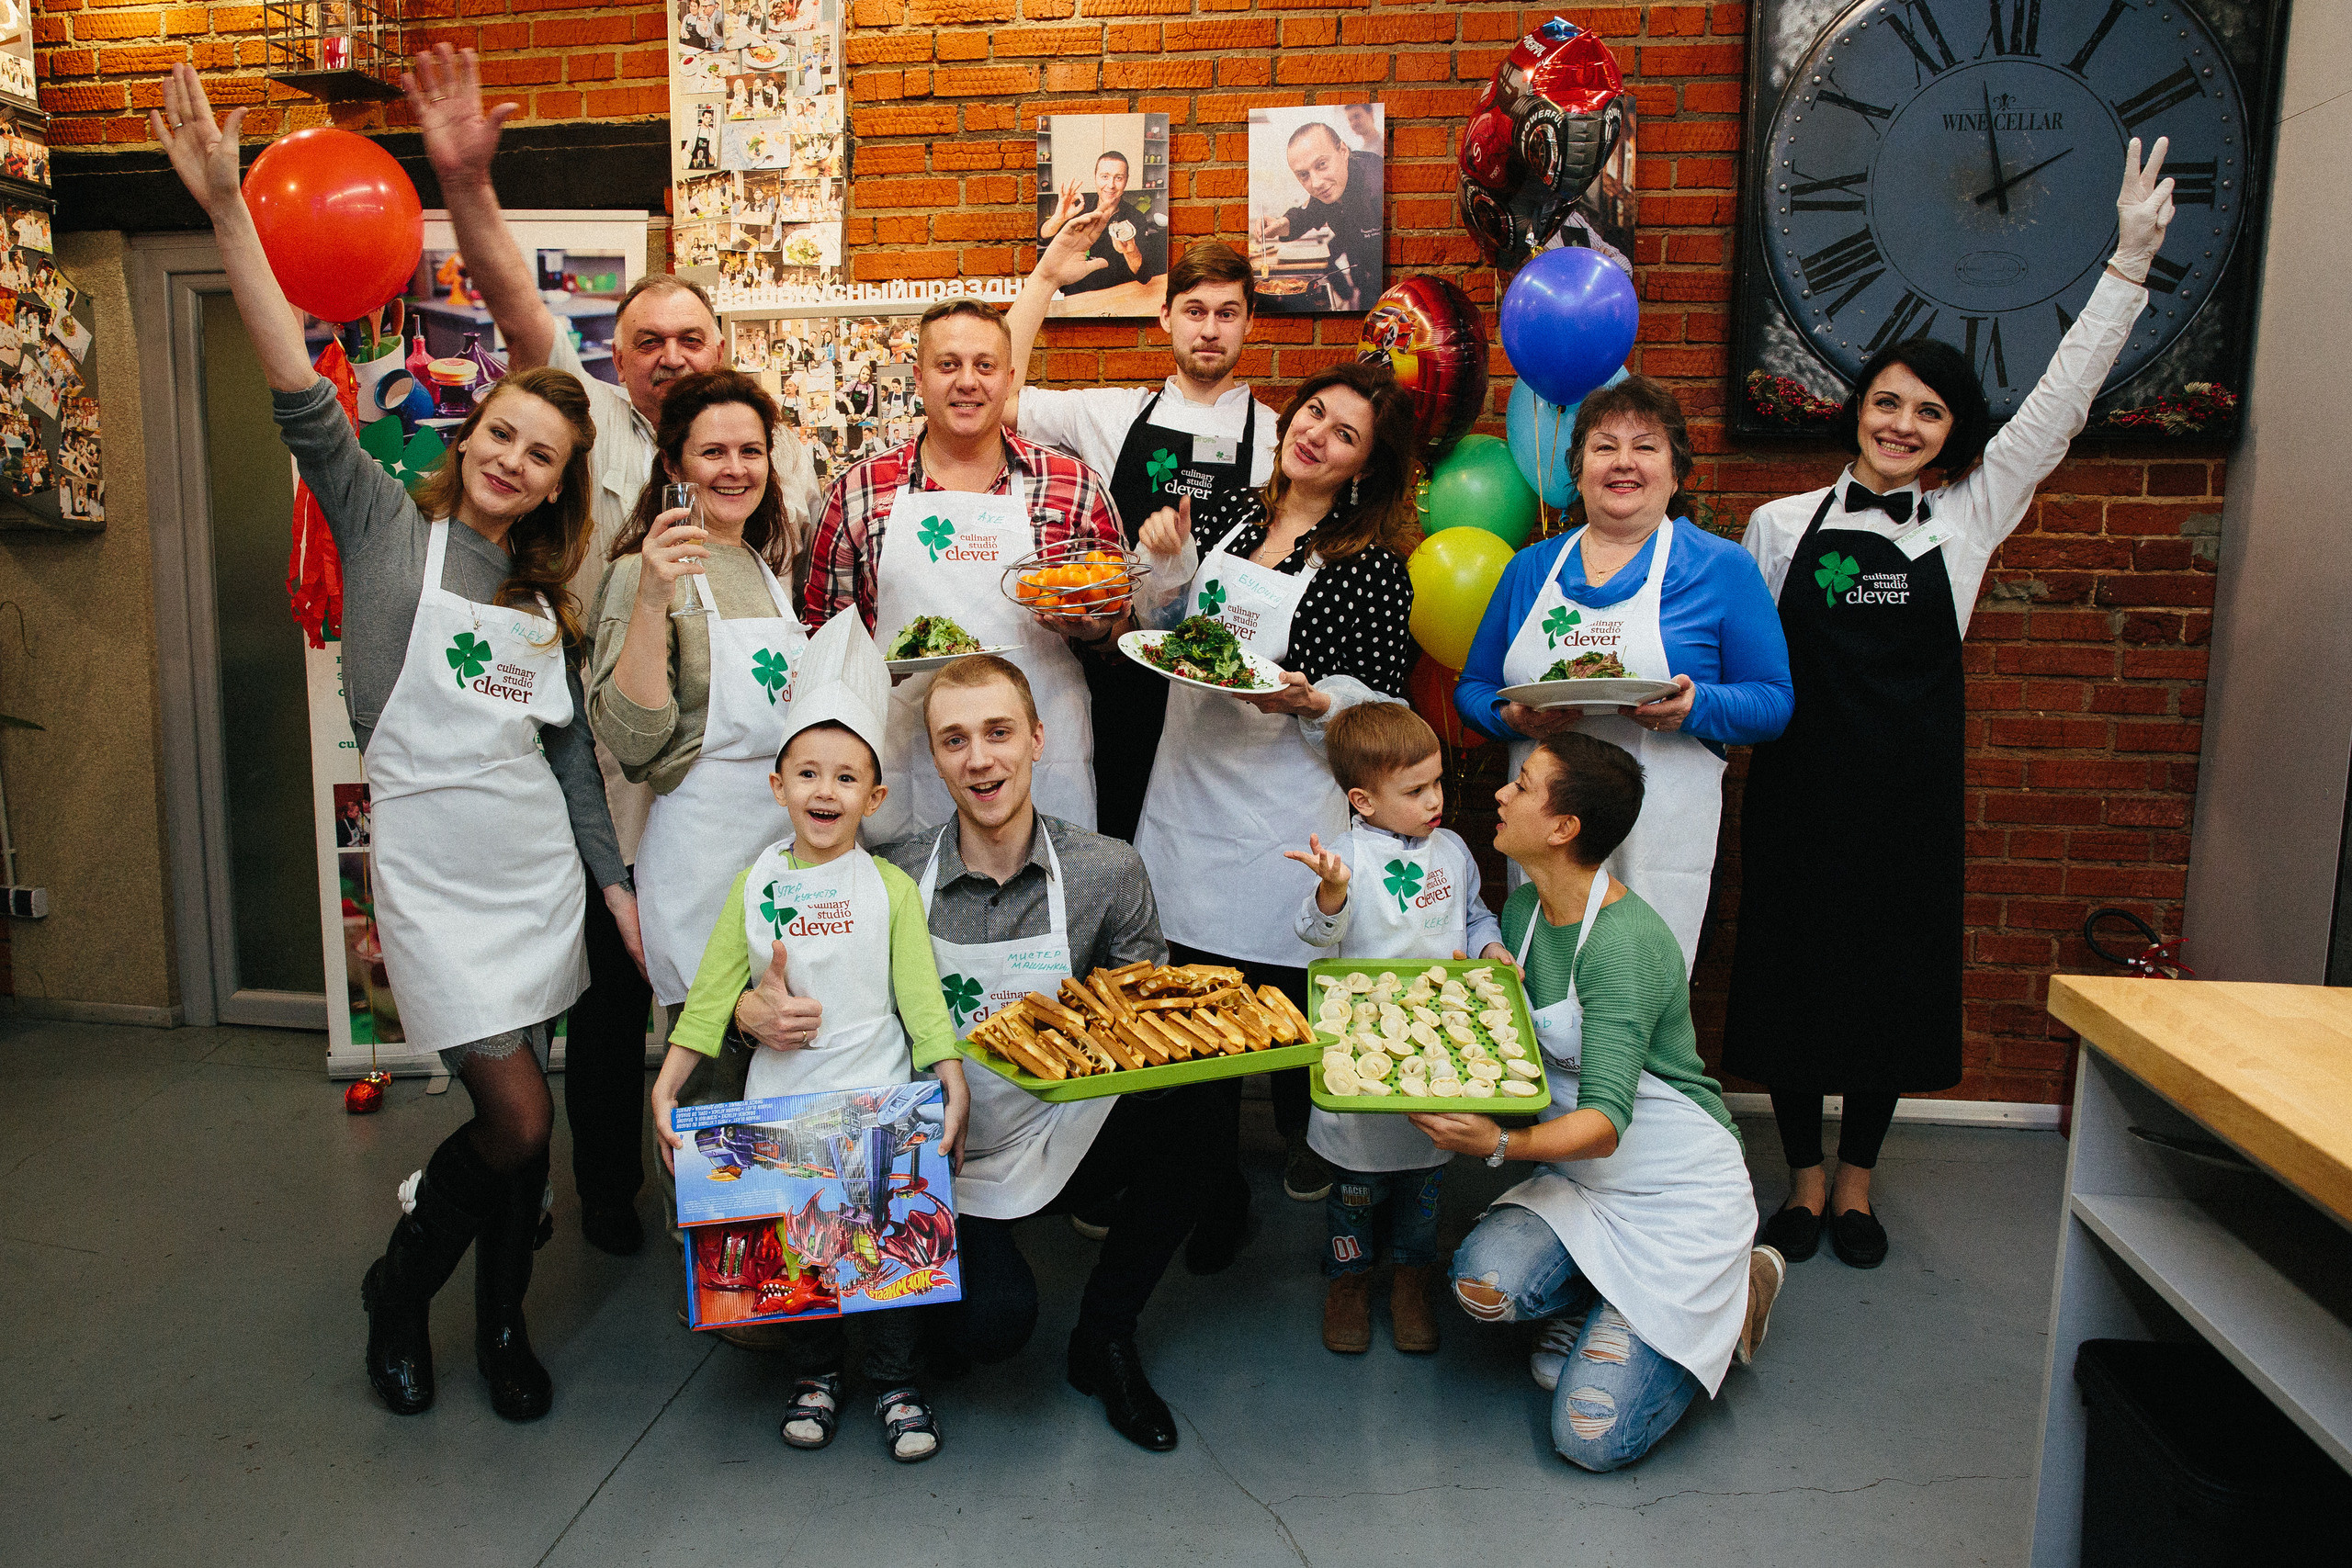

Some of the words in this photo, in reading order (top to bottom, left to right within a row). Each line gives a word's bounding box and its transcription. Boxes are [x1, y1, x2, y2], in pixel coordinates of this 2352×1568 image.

[1521, 108, 1563, 141] POWERFUL
[1942, 114, 1989, 131] WINE
[1993, 112, 2064, 130] CELLAR
[701, 276, 1064, 310] #вашвкусныйпраздн
[1181, 468, 1216, 483] culinary
[1165, 479, 1213, 501] clever
[1186, 478, 1213, 489] studio
[978, 512, 1005, 524] AXE
[960, 534, 998, 543] culinary
[945, 546, 1000, 561] clever
[1862, 572, 1907, 582] culinary
[1873, 580, 1908, 590] studio
[1846, 585, 1910, 604] clever
[1227, 604, 1261, 621] culinary
[1233, 615, 1258, 628] studio
[511, 622, 545, 642] ALEX
[1590, 626, 1622, 634] studio
[1564, 630, 1622, 647] clever
[496, 663, 537, 681] culinary
[502, 675, 533, 689] studio
[473, 675, 533, 705] clever
[777, 883, 802, 898] УТКА
[817, 909, 853, 919] studio
[788, 916, 854, 937] clever
[1007, 950, 1061, 962] МИСТЕР
[989, 990, 1032, 1000] culinar
[1342, 1186, 1369, 1195] RACER
[1333, 1235, 1362, 1261] 01
[905, 1269, 935, 1291] HOT
